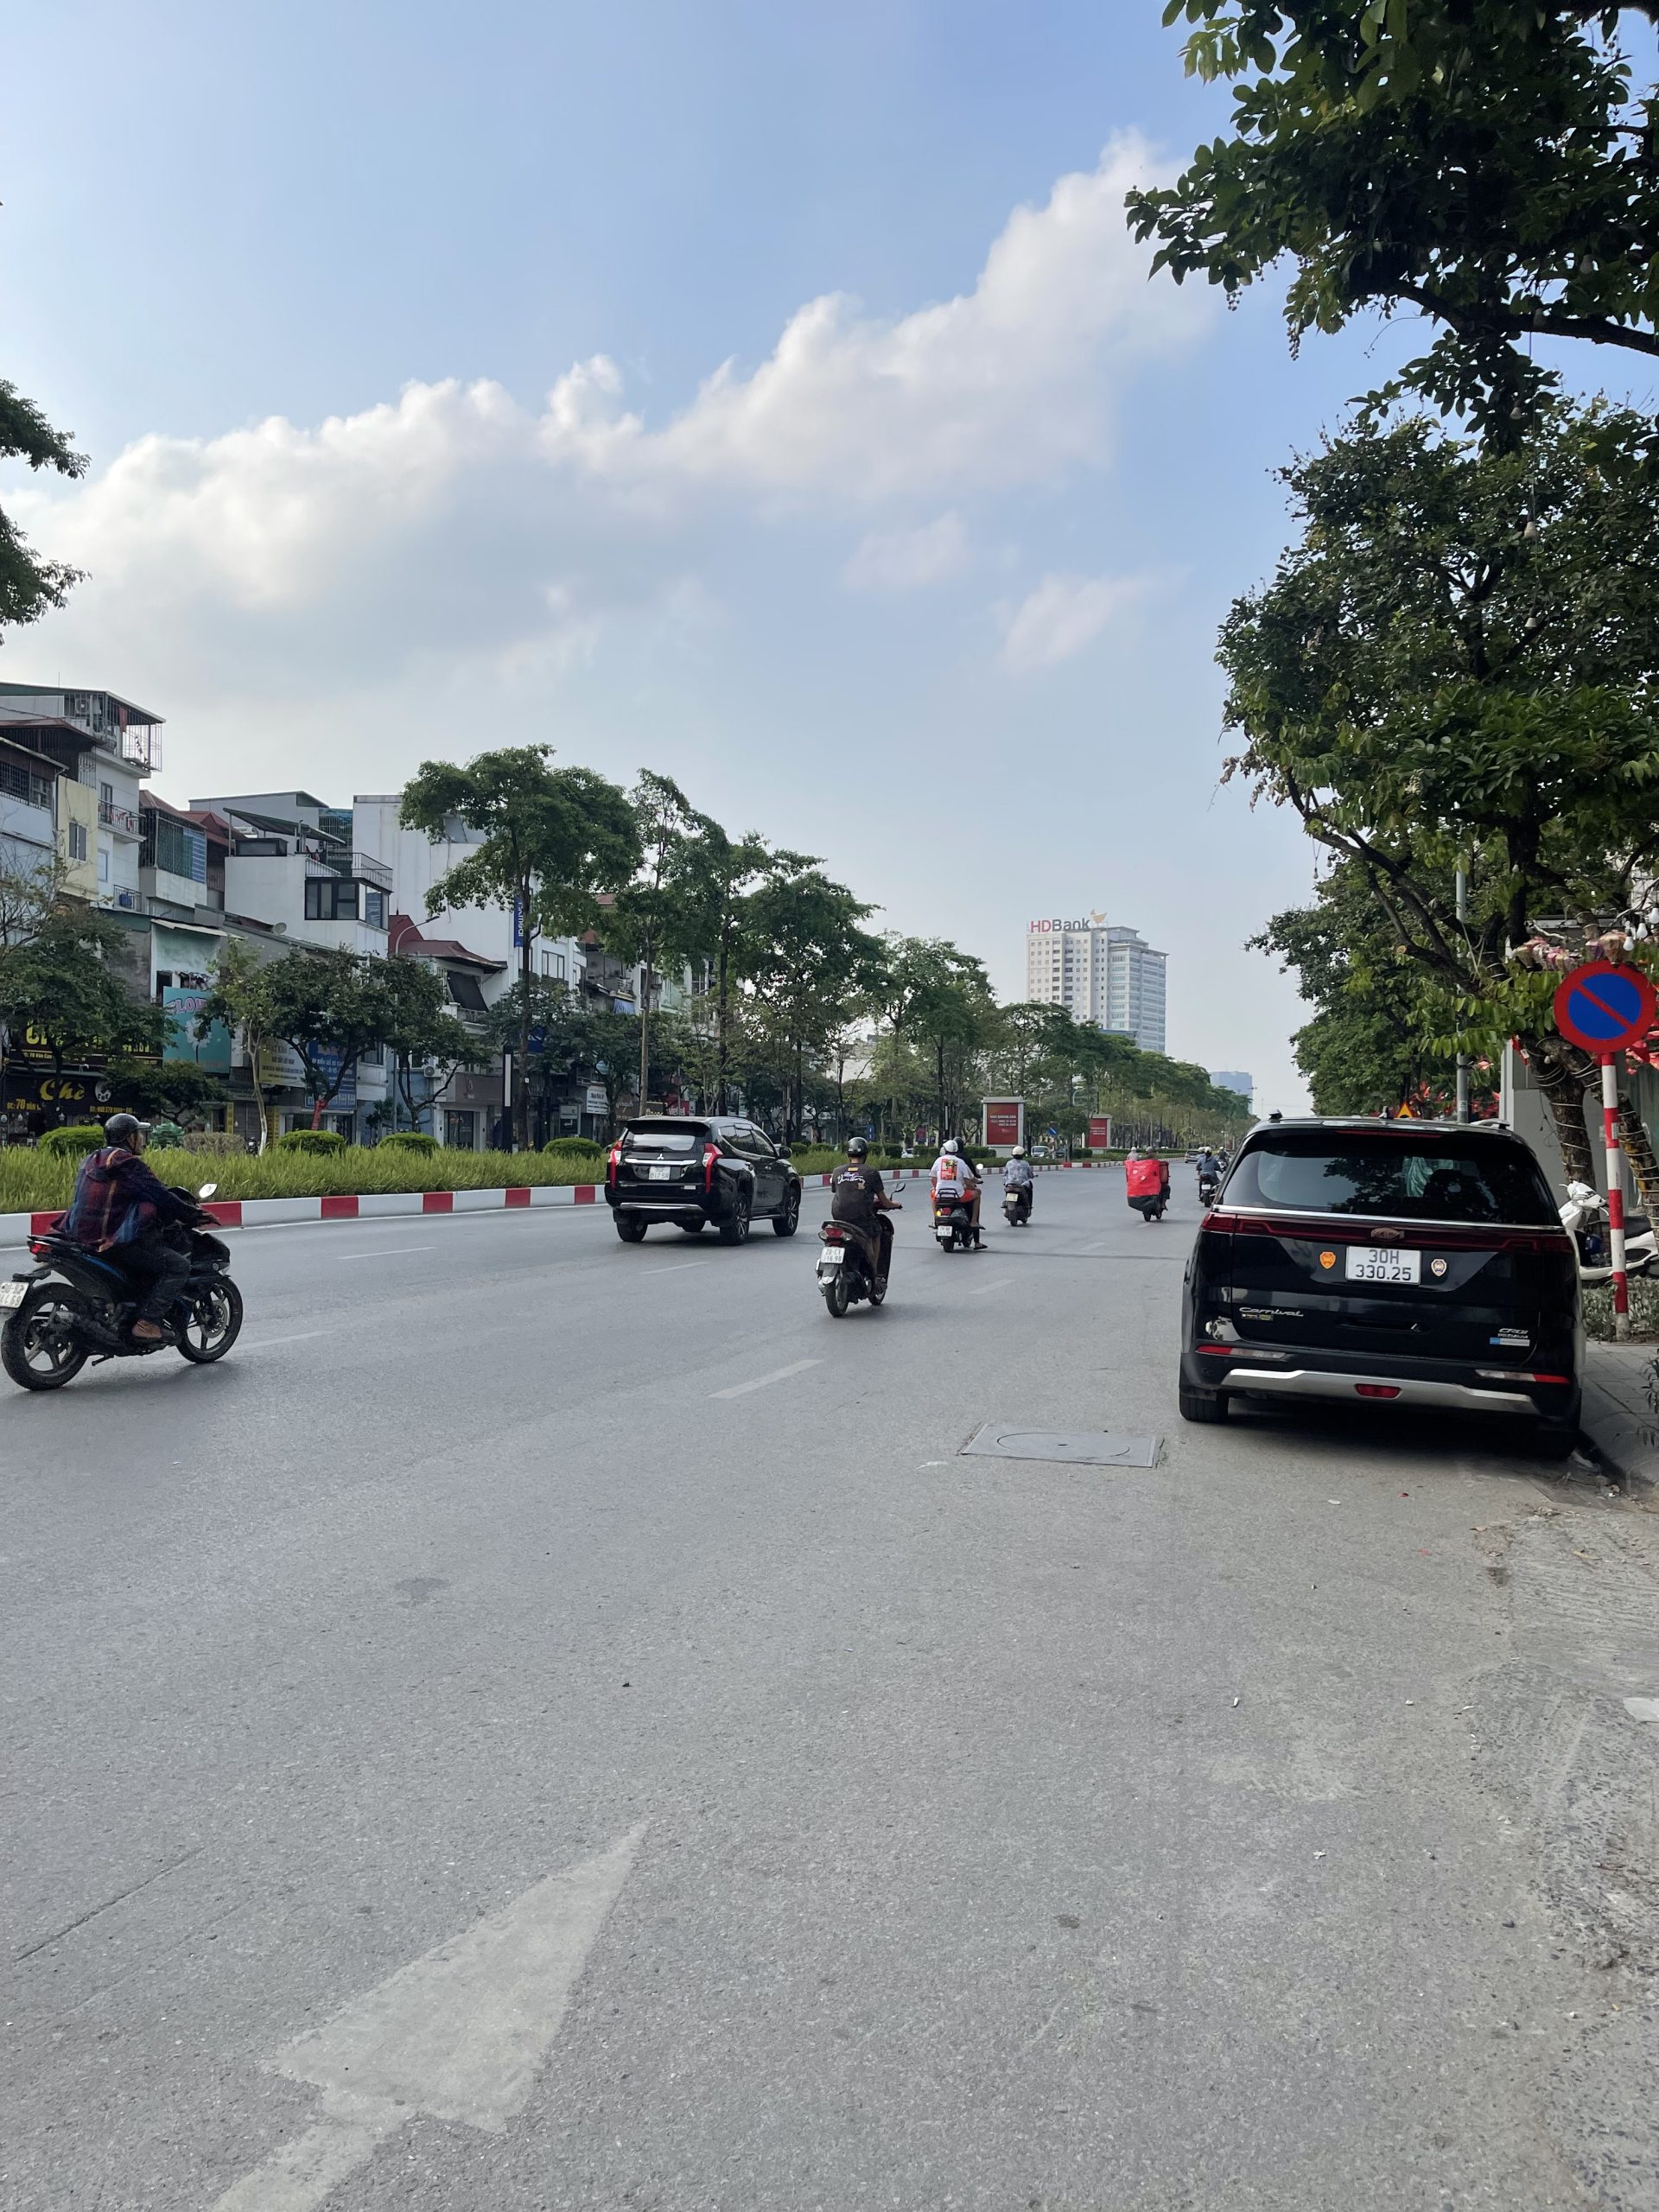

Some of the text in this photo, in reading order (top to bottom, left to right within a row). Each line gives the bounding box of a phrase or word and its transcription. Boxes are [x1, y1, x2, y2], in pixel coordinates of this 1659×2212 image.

[1030, 918, 1090, 933] HDBank
[1369, 1249, 1399, 1264] 30H
[1355, 1264, 1412, 1281] 330.25
[1239, 1306, 1304, 1317] Carnival
